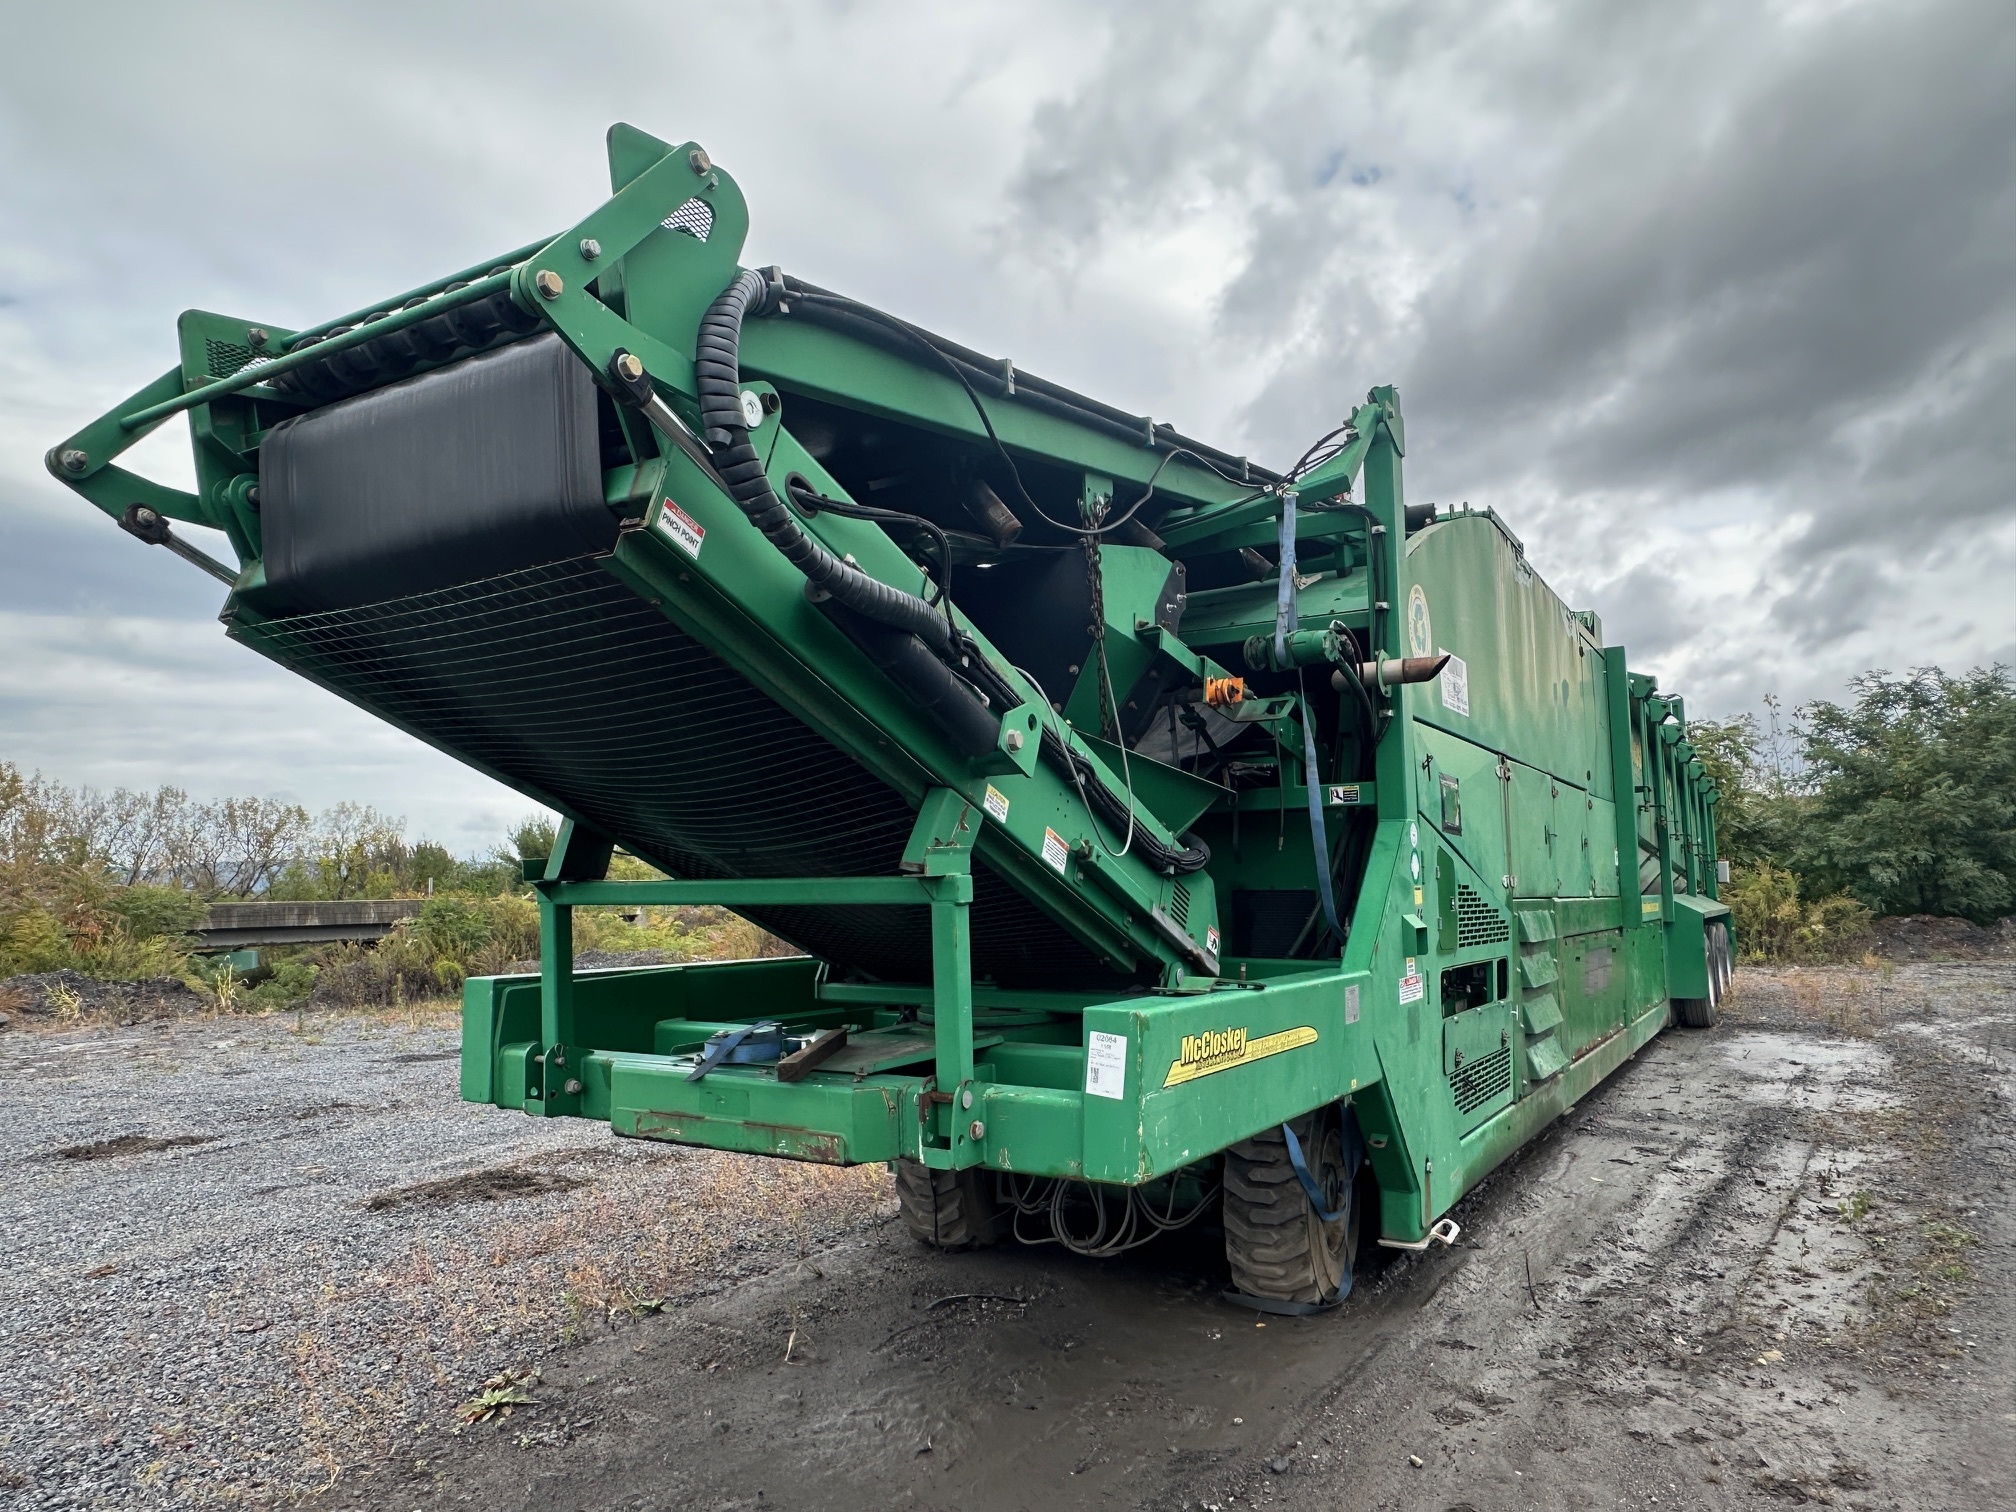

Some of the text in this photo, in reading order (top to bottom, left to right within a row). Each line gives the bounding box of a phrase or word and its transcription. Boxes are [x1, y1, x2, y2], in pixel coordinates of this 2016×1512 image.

[662, 512, 700, 548] PINCH POINT
[1181, 1025, 1248, 1067] McCloskey
